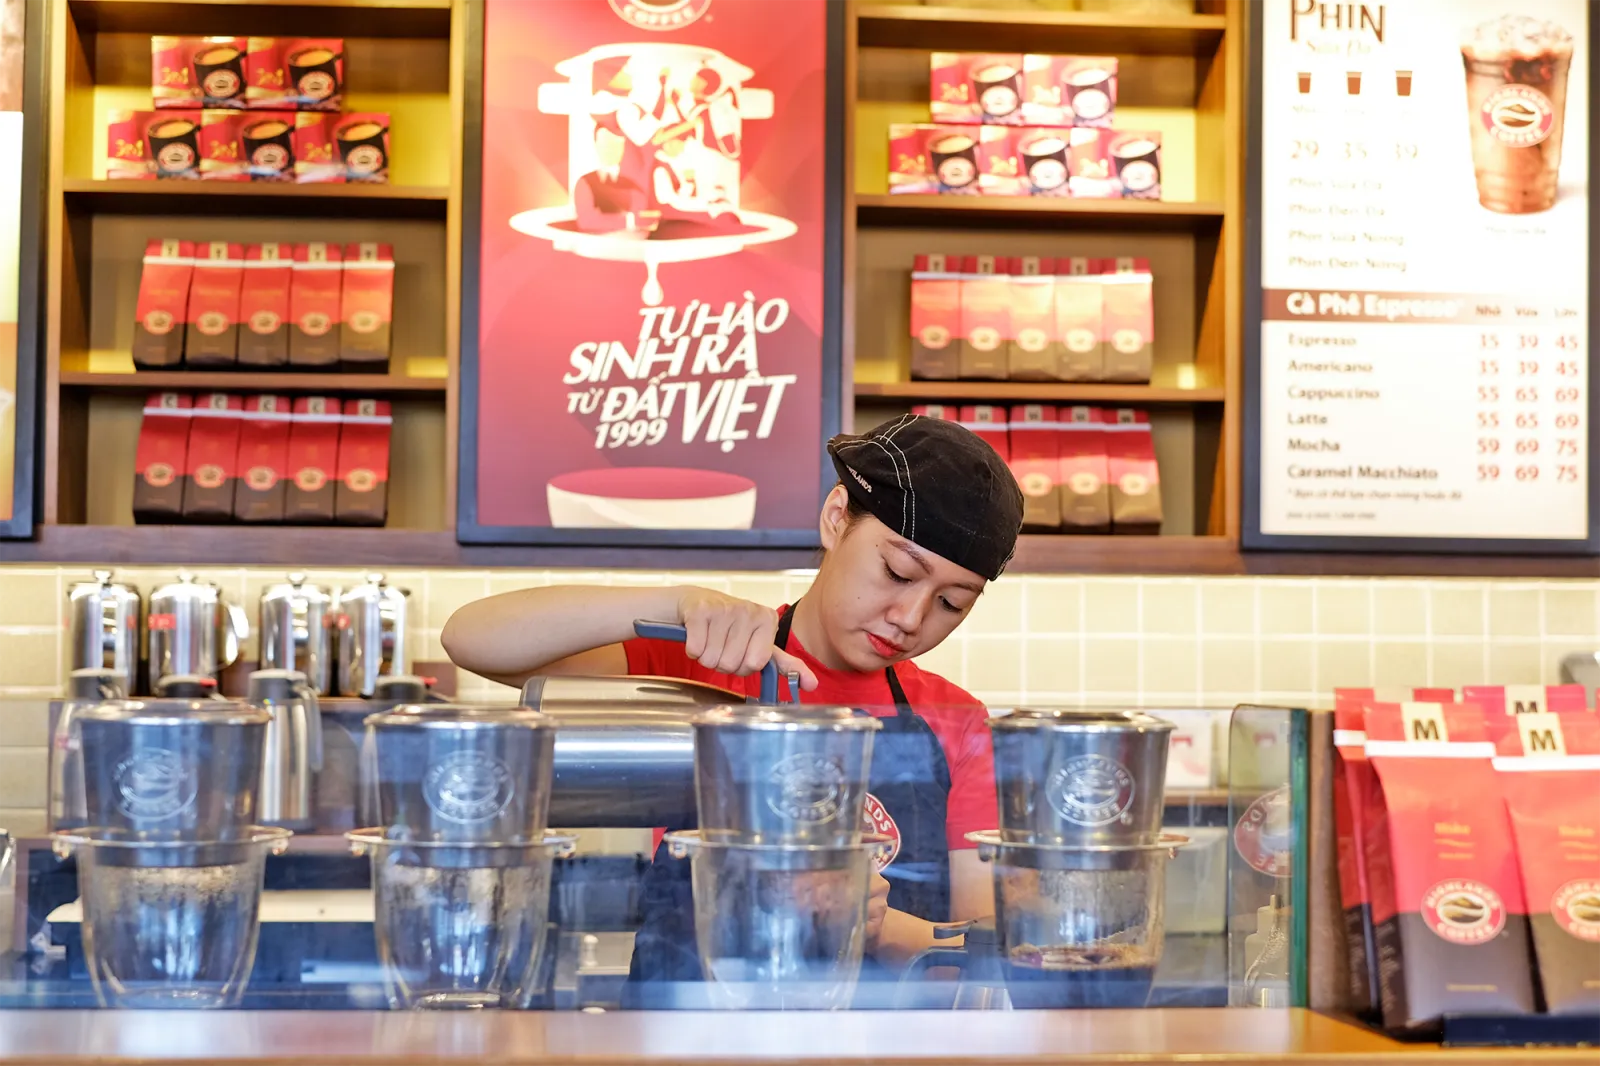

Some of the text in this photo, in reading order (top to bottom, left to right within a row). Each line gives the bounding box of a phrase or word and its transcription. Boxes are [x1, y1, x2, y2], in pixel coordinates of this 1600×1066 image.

[1287, 332, 1357, 348] Espresso
[563, 331, 759, 384] SINH RA
[1287, 359, 1374, 373] Americano
[1286, 385, 1381, 402] Cappuccino
[1515, 385, 1539, 402] 65
[1555, 386, 1579, 403] 69
[682, 370, 797, 452] VIỆT
[1287, 412, 1328, 425] Latte
[1477, 411, 1579, 430] 55 65 69
[595, 418, 668, 449] 1999
[1286, 437, 1341, 452] Mocha
[1477, 438, 1579, 456] 59 69 75
[1286, 464, 1439, 480] Caramel Macchiato
[1477, 464, 1579, 483] 59 69 75
[1413, 718, 1440, 741] M
[1529, 729, 1557, 752] M
